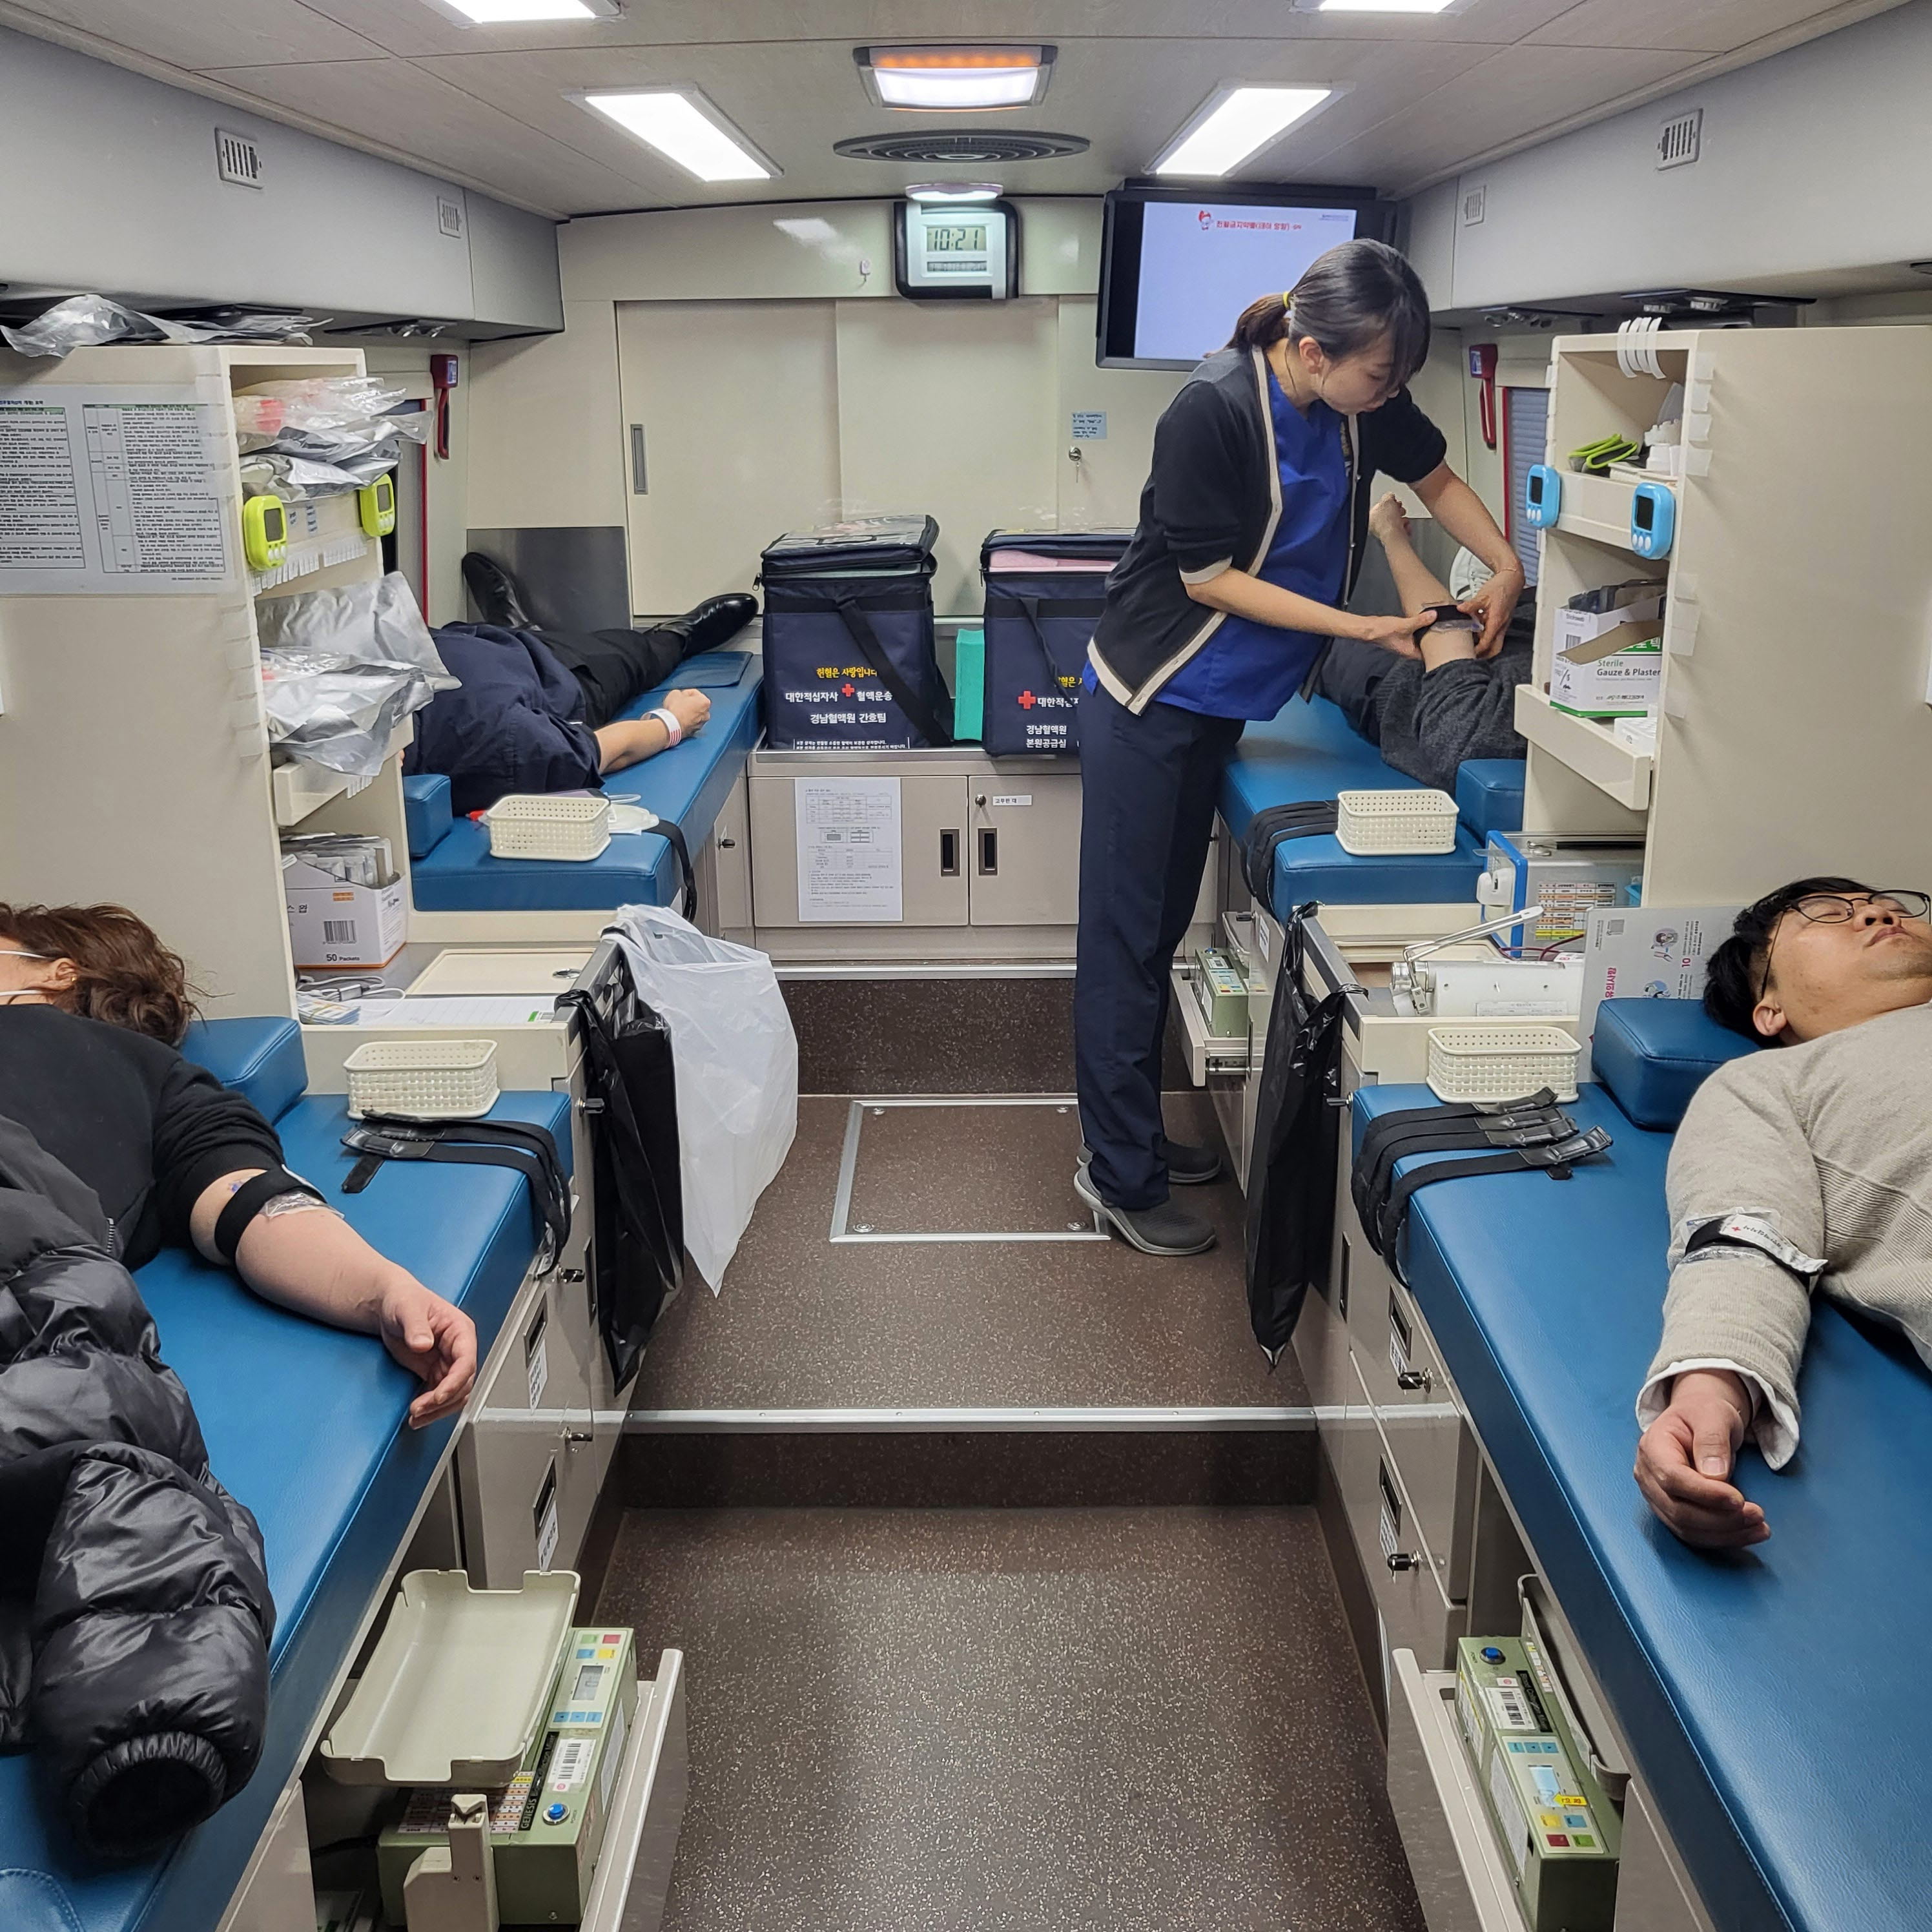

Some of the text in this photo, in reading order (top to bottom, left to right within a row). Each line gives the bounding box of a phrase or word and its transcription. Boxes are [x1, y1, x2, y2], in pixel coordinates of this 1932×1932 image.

[934, 229, 978, 251] 10:21
[816, 667, 839, 678] 헌혈은
[785, 691, 893, 703] 대한적십자사 혈액운송
[810, 712, 887, 724] 경남혈액원 간호팀
[1026, 724, 1067, 735] 경남혈액원
[1026, 738, 1067, 748] 본원공급실
[1681, 958, 1691, 968] 10
[1605, 967, 1616, 998] 유의사항
[521, 1798, 537, 1829] GENESIS
